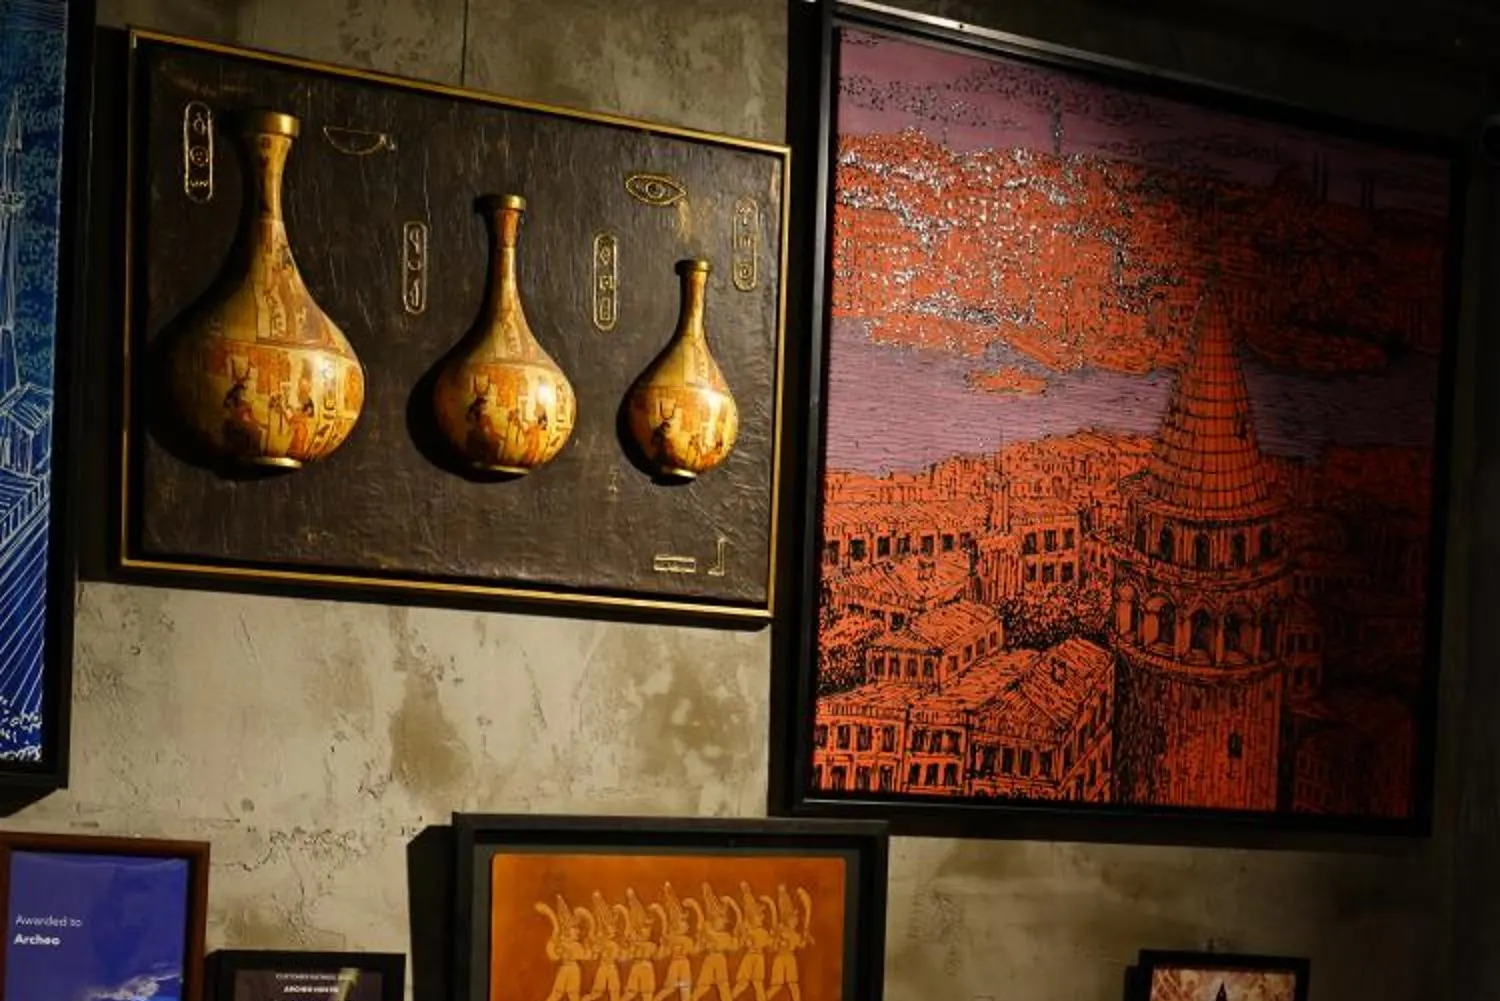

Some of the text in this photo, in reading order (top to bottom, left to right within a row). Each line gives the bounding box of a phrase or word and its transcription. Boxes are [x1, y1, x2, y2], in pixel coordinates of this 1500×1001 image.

[16, 915, 83, 927] Awarded to
[13, 933, 61, 945] Archeo
